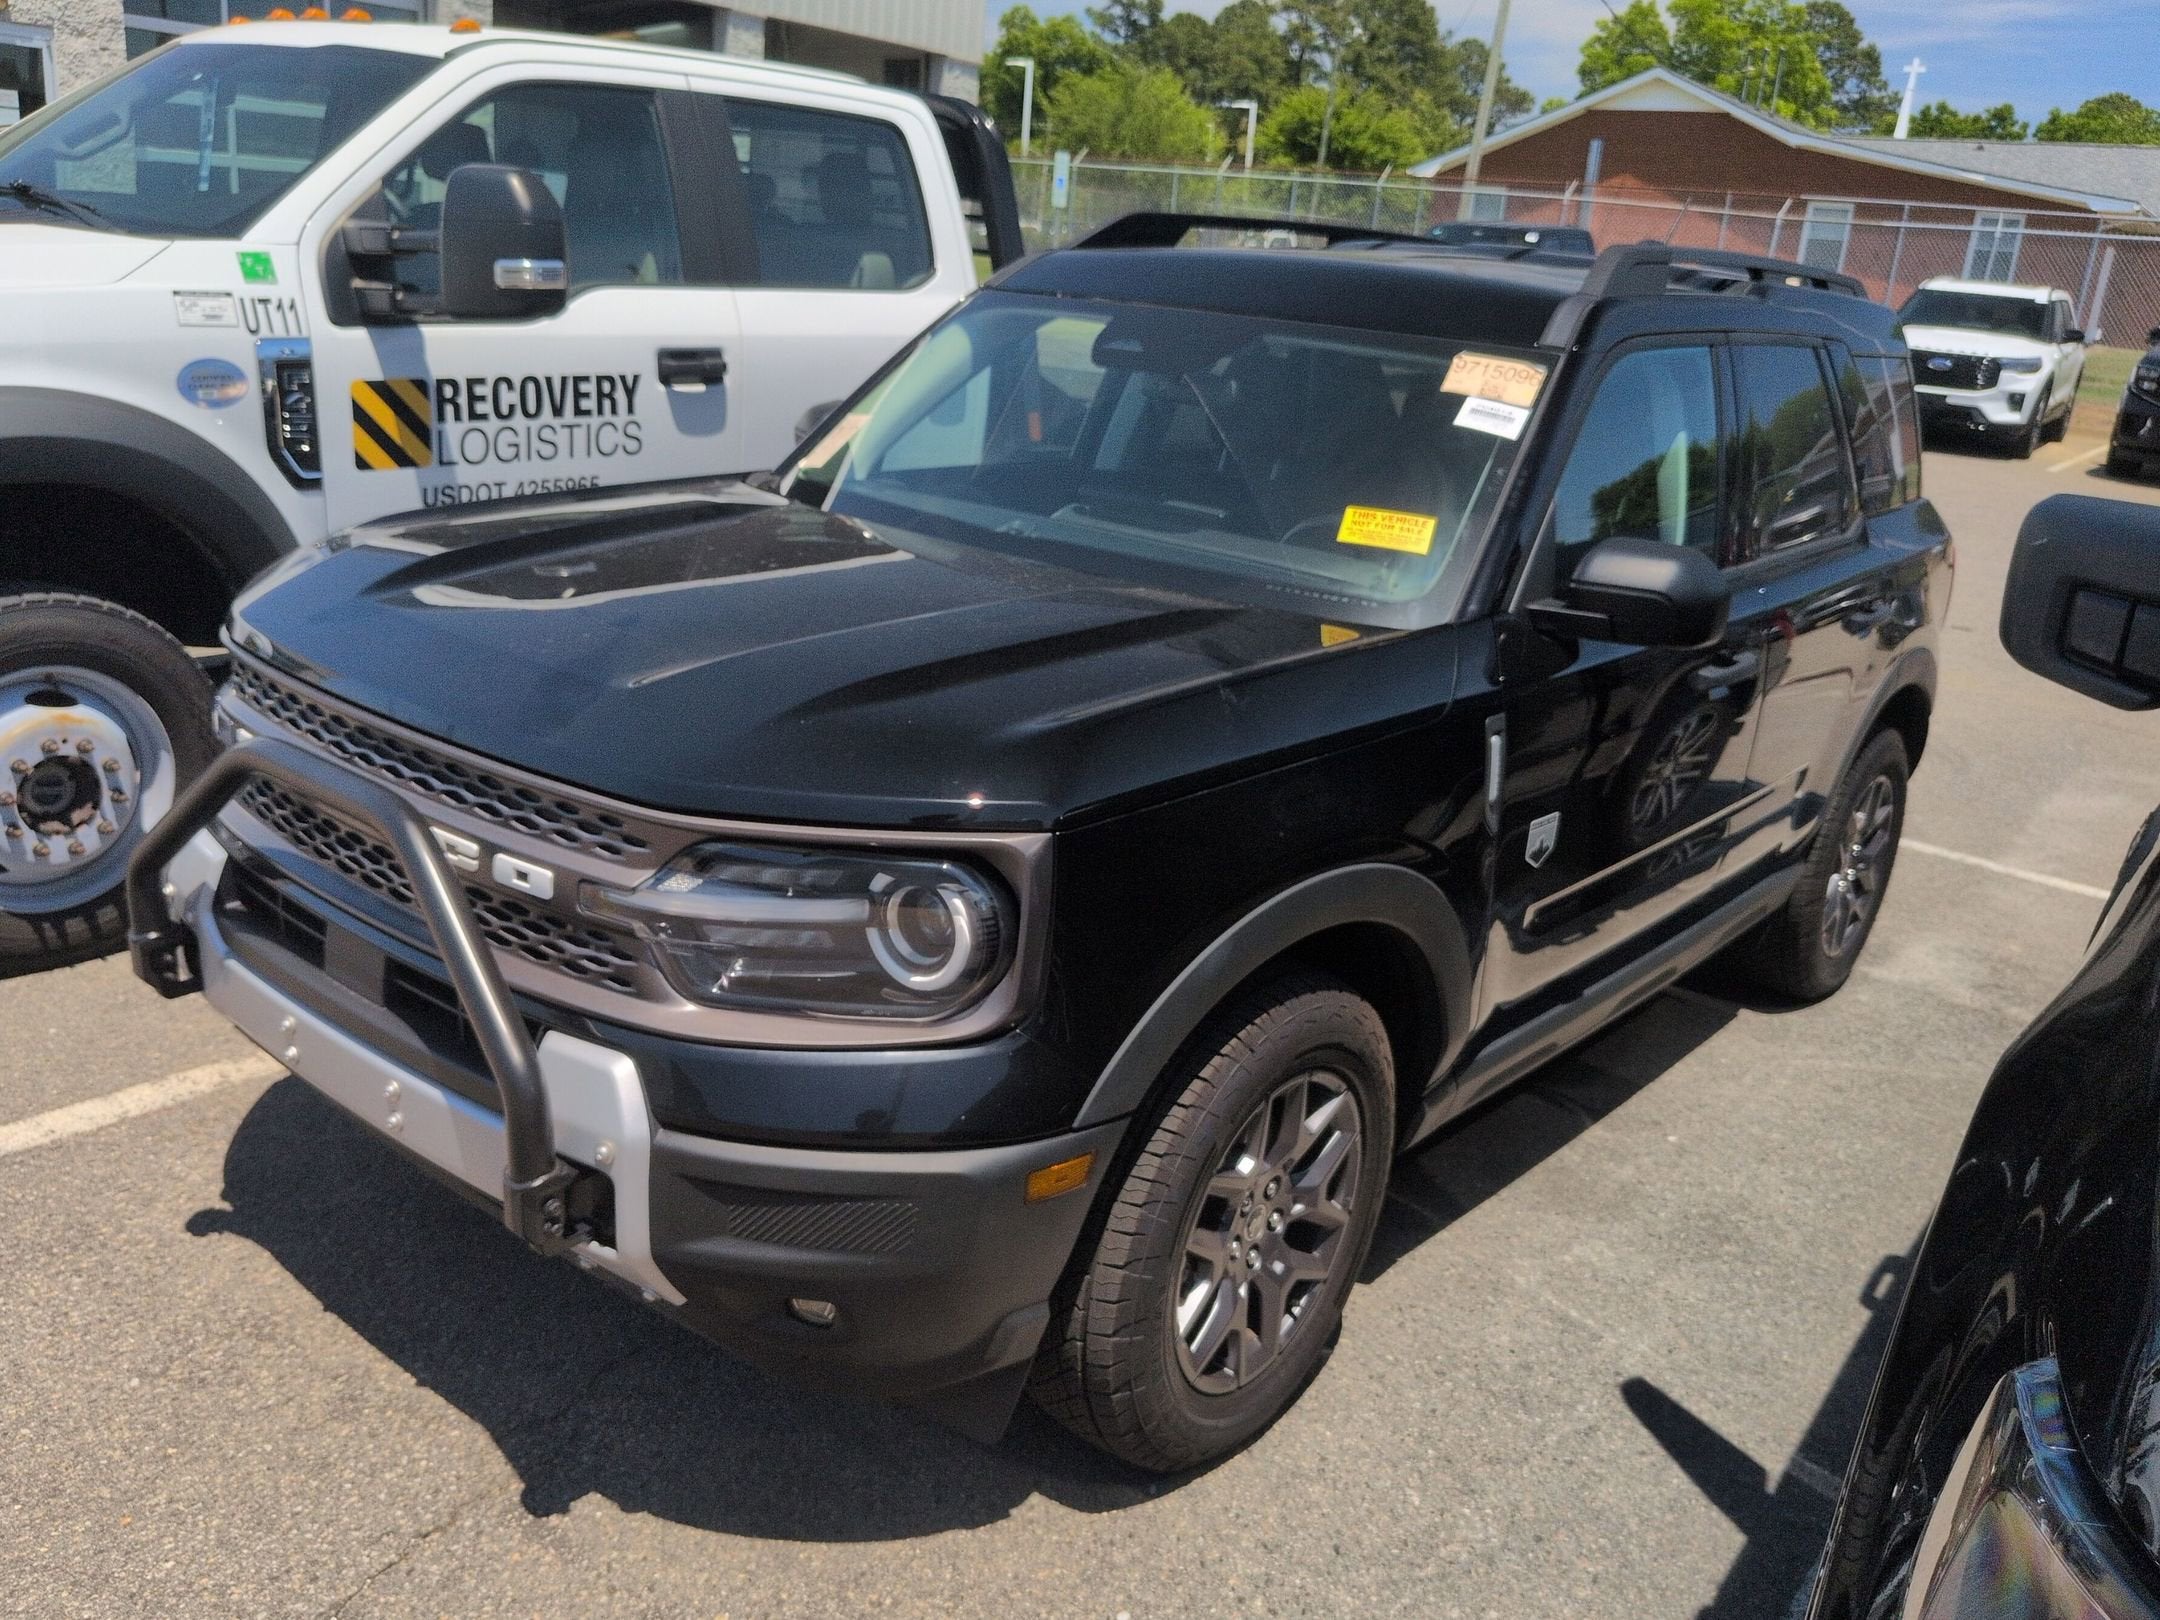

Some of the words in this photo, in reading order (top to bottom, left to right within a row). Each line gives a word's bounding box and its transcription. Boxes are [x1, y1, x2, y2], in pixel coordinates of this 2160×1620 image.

[240, 298, 302, 335] UT11
[435, 374, 641, 423] RECOVERY
[437, 420, 643, 466] LOGISTICS
[423, 482, 507, 508] USDOT
[1381, 514, 1429, 528] VEHICLE
